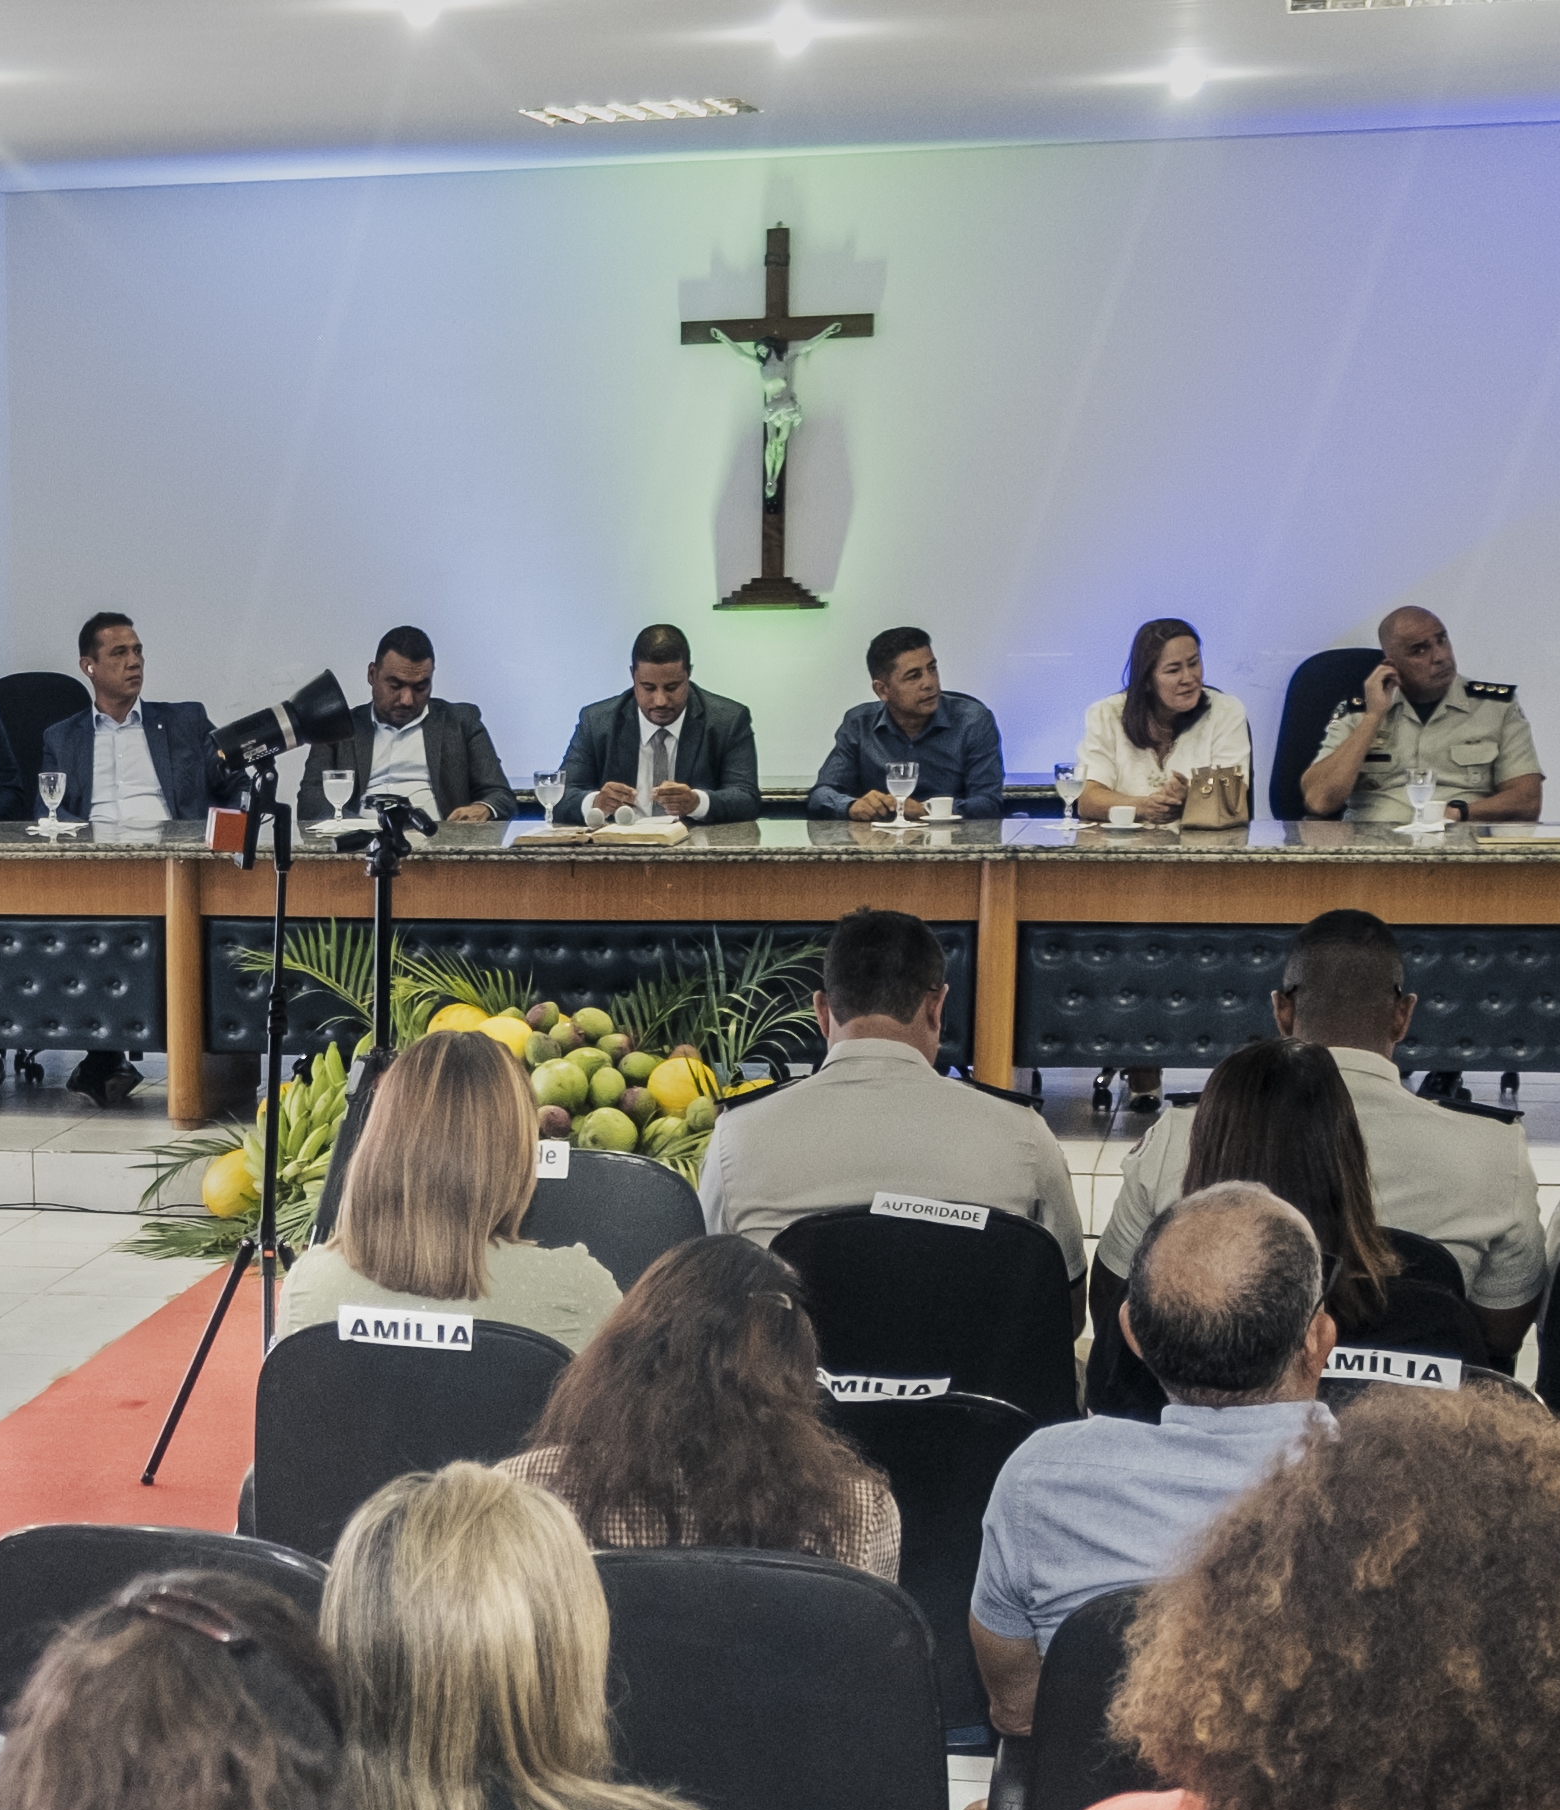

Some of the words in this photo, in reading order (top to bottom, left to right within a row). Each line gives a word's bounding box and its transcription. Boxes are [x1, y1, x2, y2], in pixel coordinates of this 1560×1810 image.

[880, 1200, 982, 1223] AUTORIDADE
[1326, 1351, 1442, 1383] MÍLIA
[822, 1373, 931, 1397] MÍLIA
